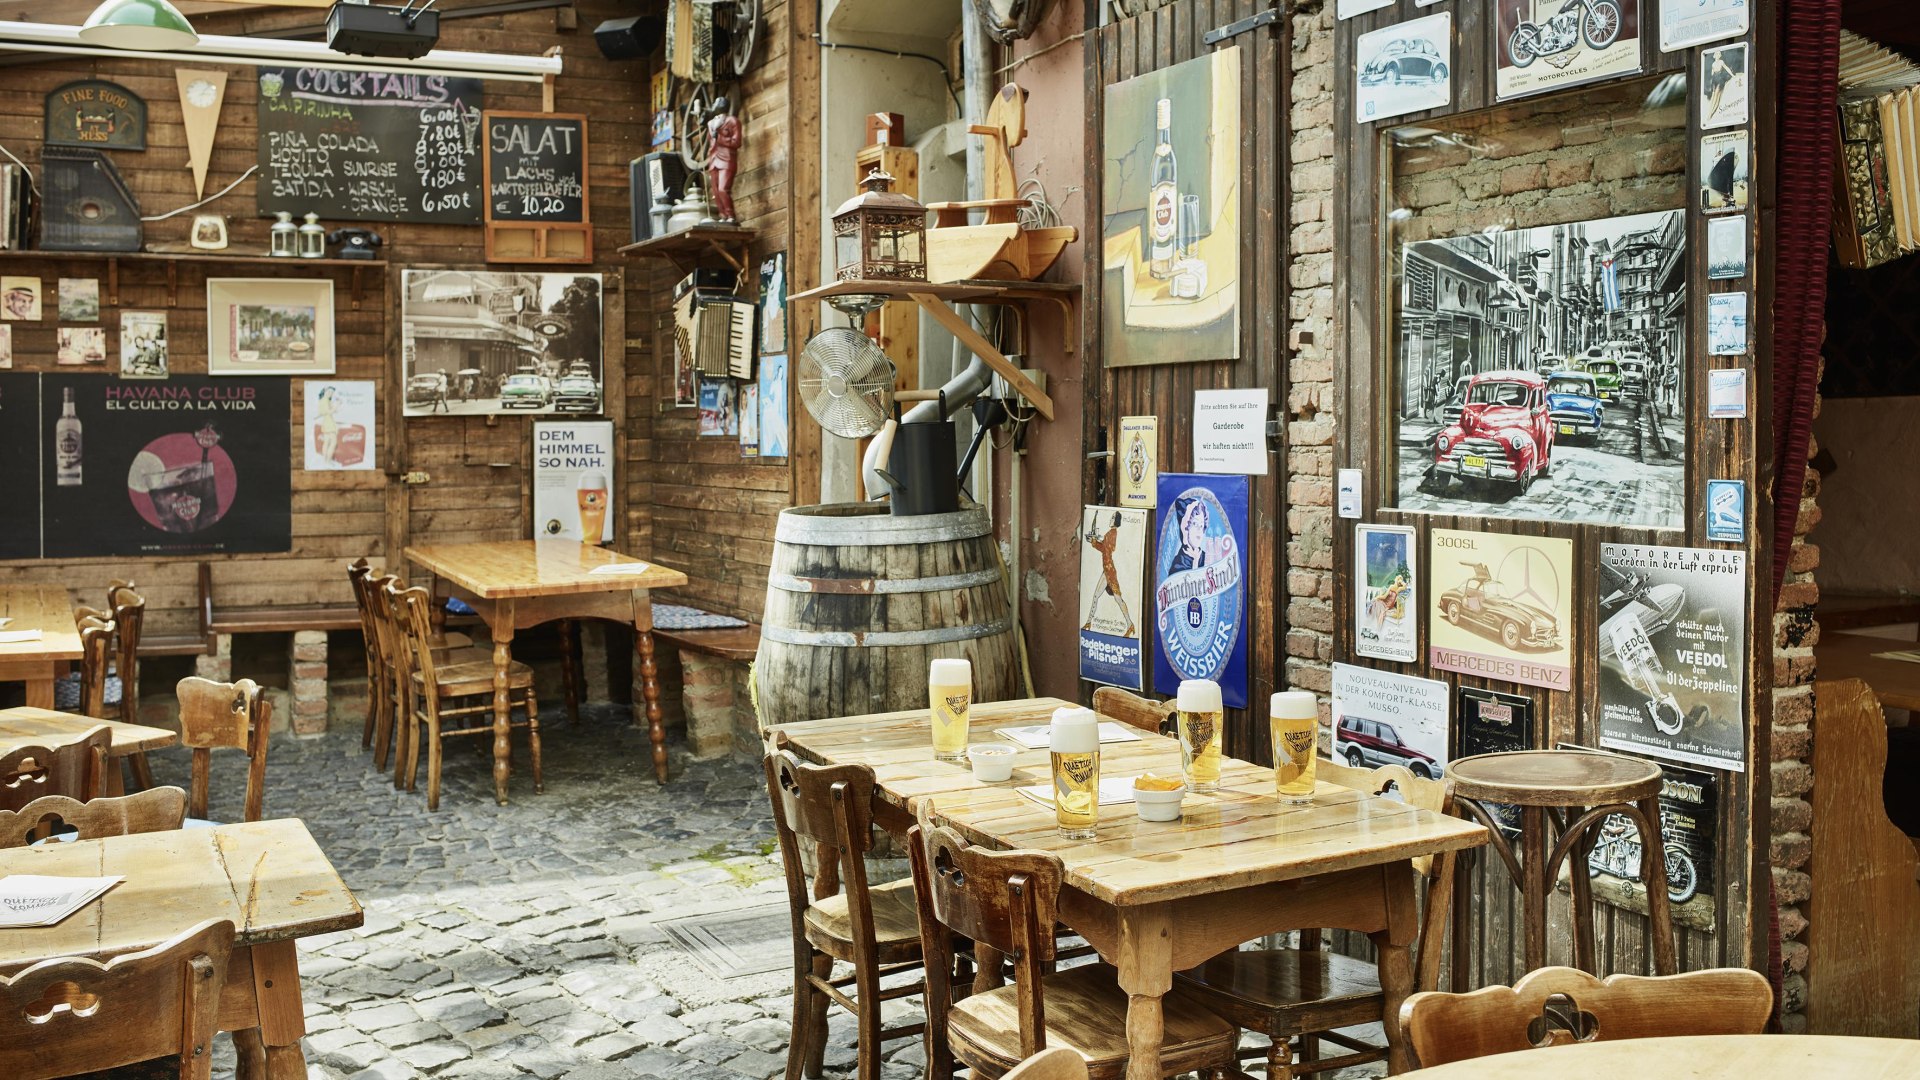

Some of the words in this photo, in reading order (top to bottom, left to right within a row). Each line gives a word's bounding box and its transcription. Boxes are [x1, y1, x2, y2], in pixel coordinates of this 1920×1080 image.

[1538, 67, 1588, 82] MOTORCYCLES
[296, 68, 449, 102] COCKTAILS
[62, 89, 94, 104] FINE
[99, 90, 127, 109] FOOD
[269, 131, 308, 147] PIÑA
[317, 133, 380, 153] COLADA
[491, 124, 576, 155] SALAT
[270, 148, 329, 163] MOJITO
[269, 162, 334, 184] TEQUILA
[343, 160, 397, 177] SUNRISE
[505, 166, 555, 182] LACHS
[272, 179, 334, 198] BATIDA
[349, 181, 397, 197] KIRSCH
[351, 197, 409, 212] ORANGE
[521, 195, 565, 216] 10,20
[105, 386, 191, 399] HAVANA
[198, 386, 256, 399] CLUB
[106, 400, 125, 410] EL
[129, 400, 179, 410] CULTO
[183, 400, 194, 410] A
[198, 400, 217, 410] LA
[222, 400, 256, 410] VIDA
[1212, 422, 1244, 430] Garderobe
[539, 431, 574, 440] DEM
[539, 444, 605, 454] HIMMEL
[1213, 442, 1231, 450] haften
[539, 458, 561, 468] SO
[566, 458, 605, 468] NAH.
[180, 506, 197, 516] Club
[1437, 536, 1478, 550] 300SL
[1611, 557, 1646, 568] werden
[1649, 558, 1659, 568] in
[1663, 560, 1678, 570] der
[1680, 560, 1698, 573] Luft
[1701, 563, 1739, 574] erprobt
[1189, 612, 1200, 625] HB
[1676, 620, 1703, 630] schütze
[1705, 623, 1724, 633] auch
[1676, 630, 1702, 640] deinen
[1703, 632, 1729, 643] Motor
[1080, 636, 1138, 657] Radeberger
[1168, 621, 1233, 677] WEISSBIER
[1359, 644, 1414, 657] MERCEDES-BENZ
[1618, 634, 1649, 661] VEEDOL
[1693, 641, 1705, 651] mit
[1088, 649, 1124, 664] Pilsner
[1676, 649, 1728, 668] VEEDOL
[1436, 651, 1515, 677] MERCEDES
[1520, 665, 1563, 684] BENZ
[1692, 665, 1707, 675] dem
[1349, 674, 1428, 697] NOUVEAU-NIVEAU
[1667, 671, 1676, 686] Öl
[1678, 675, 1693, 687] der
[1692, 676, 1738, 694] Zeppeline
[1335, 682, 1343, 691] IN
[1345, 684, 1359, 694] DER
[1362, 688, 1445, 711] KOMFORT-KLASSE.
[1368, 701, 1402, 715] MUSSO.
[1604, 704, 1628, 713] umhüllt
[1628, 705, 1640, 716] alle
[1604, 711, 1632, 722] gleitenden
[1631, 714, 1643, 724] Teile
[1604, 729, 1626, 739] sparsam
[1631, 733, 1671, 749] hitzebeständig
[1676, 741, 1699, 752] enorme
[1702, 744, 1742, 760] Schmierkraft
